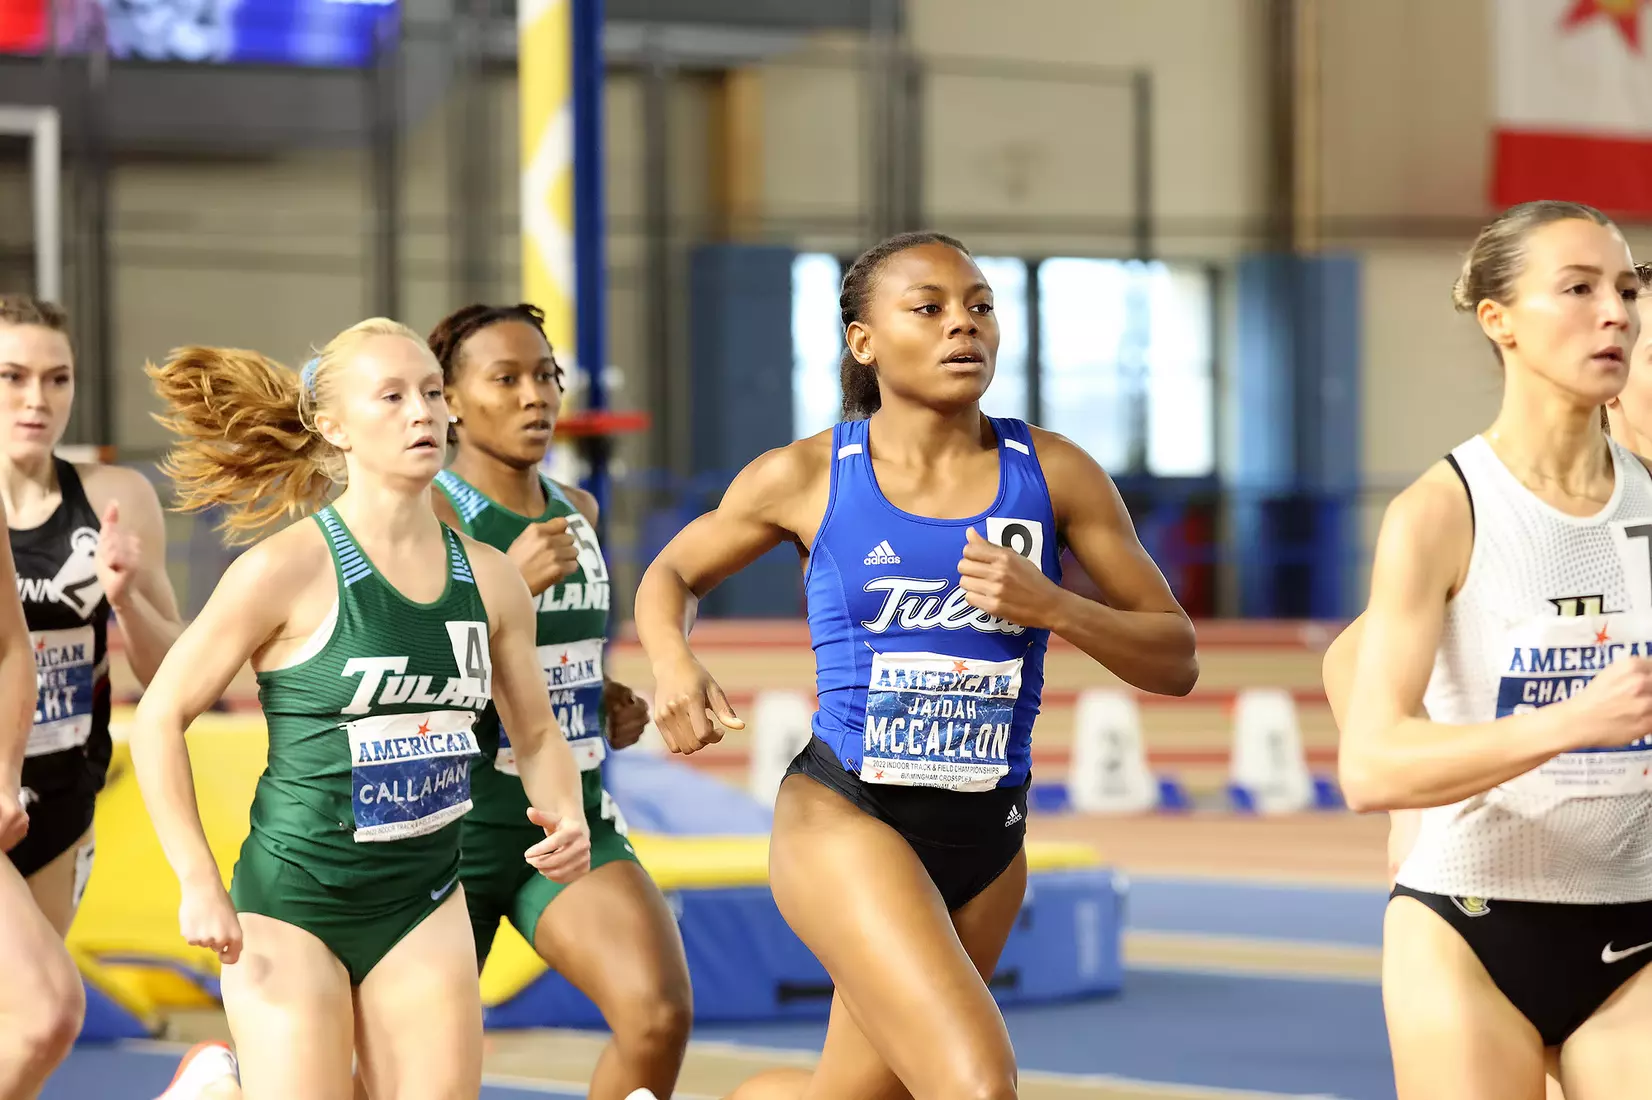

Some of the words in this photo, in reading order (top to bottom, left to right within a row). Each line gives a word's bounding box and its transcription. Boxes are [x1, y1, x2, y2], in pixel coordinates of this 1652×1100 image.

[863, 554, 901, 566] adidas
[465, 627, 487, 694] 4
[1509, 642, 1652, 673] AMERIC
[876, 668, 1012, 696] AMERICAN
[908, 697, 977, 720] JAIDAH
[358, 731, 473, 764] AMERICAN
[865, 715, 1010, 760] MCCALLON
[359, 761, 468, 804] CALLAHAN
